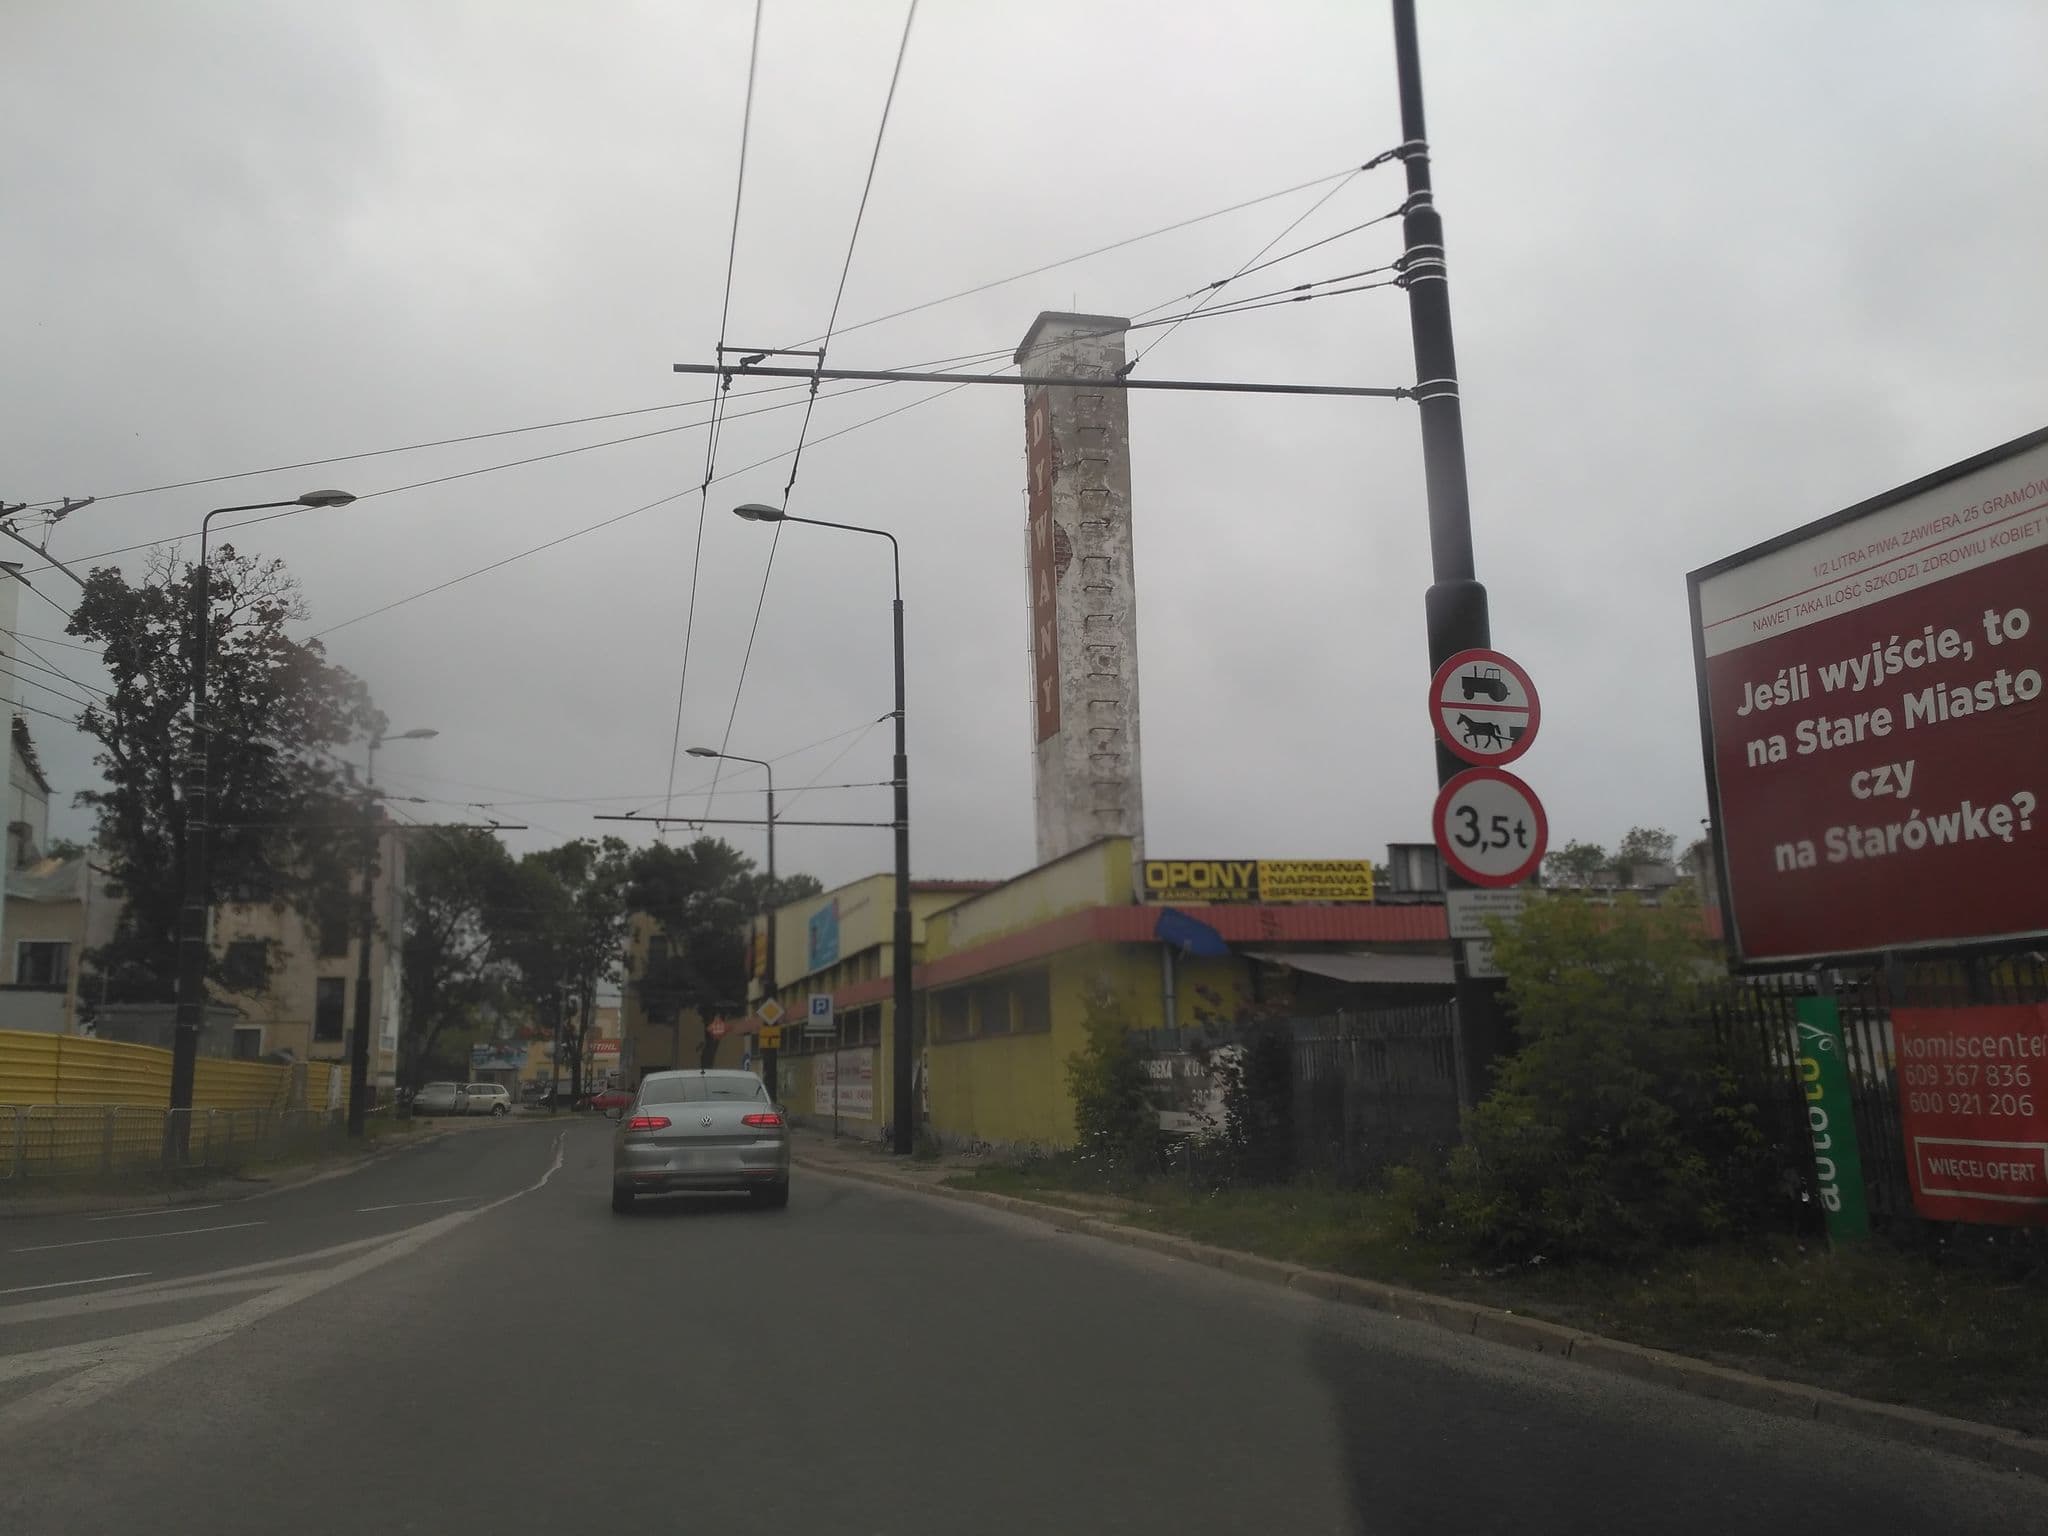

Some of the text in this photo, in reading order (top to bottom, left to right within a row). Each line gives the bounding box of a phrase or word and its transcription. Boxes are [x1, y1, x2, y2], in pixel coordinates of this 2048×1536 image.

[1031, 408, 1054, 714] DYWANY
[1812, 559, 1829, 578] 1/2
[1831, 549, 1867, 573] LITRA
[1867, 536, 1899, 560] PIWA
[1901, 513, 1961, 545] ZAWIERA
[1963, 505, 1979, 523] 25
[1752, 608, 1793, 633] NAWET
[1793, 597, 1824, 618] TAKA
[1825, 579, 1862, 607] ILOŚĆ
[1863, 563, 1919, 594] SZKODZI
[1921, 542, 1986, 574] ZDROWIU
[1989, 518, 2042, 549] KOBIET
[1736, 606, 2030, 718] Jeśli wyjście, to
[1746, 665, 2042, 768] na Stare Miasto
[1850, 759, 1917, 800] czy
[1774, 791, 2037, 872] na Starówkę?
[1145, 861, 1254, 889] OPONY
[1268, 862, 1366, 873] WYMIANA
[1268, 875, 1368, 885] NAPRAWA
[1905, 1063, 2032, 1088] 609 367 836
[1909, 1092, 2035, 1117] 600 921 206
[1928, 1157, 2036, 1183] WIĘCEJ OFERT
